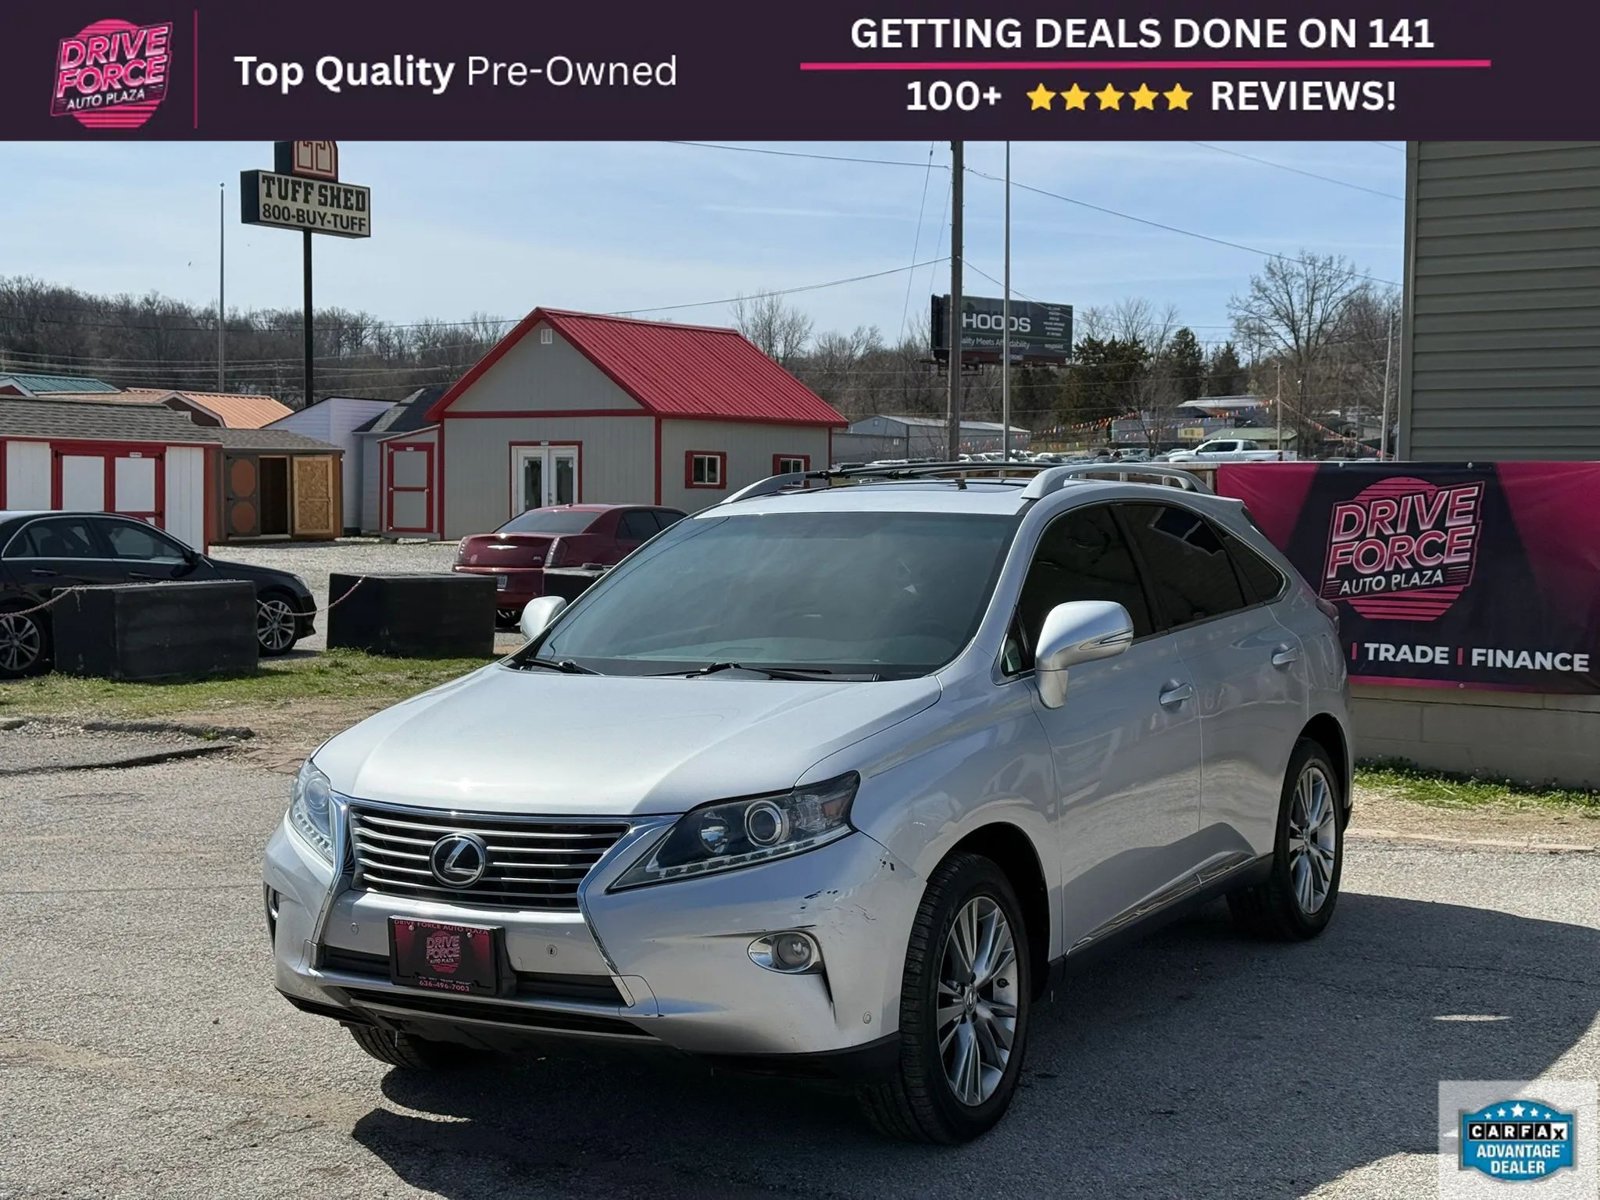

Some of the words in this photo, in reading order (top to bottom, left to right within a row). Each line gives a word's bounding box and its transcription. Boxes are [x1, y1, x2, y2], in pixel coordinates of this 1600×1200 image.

[262, 175, 315, 204] TUFF
[318, 184, 366, 212] SHED
[262, 203, 366, 231] 800-BUY-TUFF
[1332, 485, 1480, 544] DRIVE
[1326, 524, 1478, 580] FORCE
[1339, 575, 1386, 595] AUTO
[1391, 569, 1444, 591] PLAZA
[1364, 642, 1450, 665] TRADE
[1471, 648, 1590, 673] FINANCE
[426, 935, 460, 949] DRIVE
[426, 946, 460, 960] FORCE
